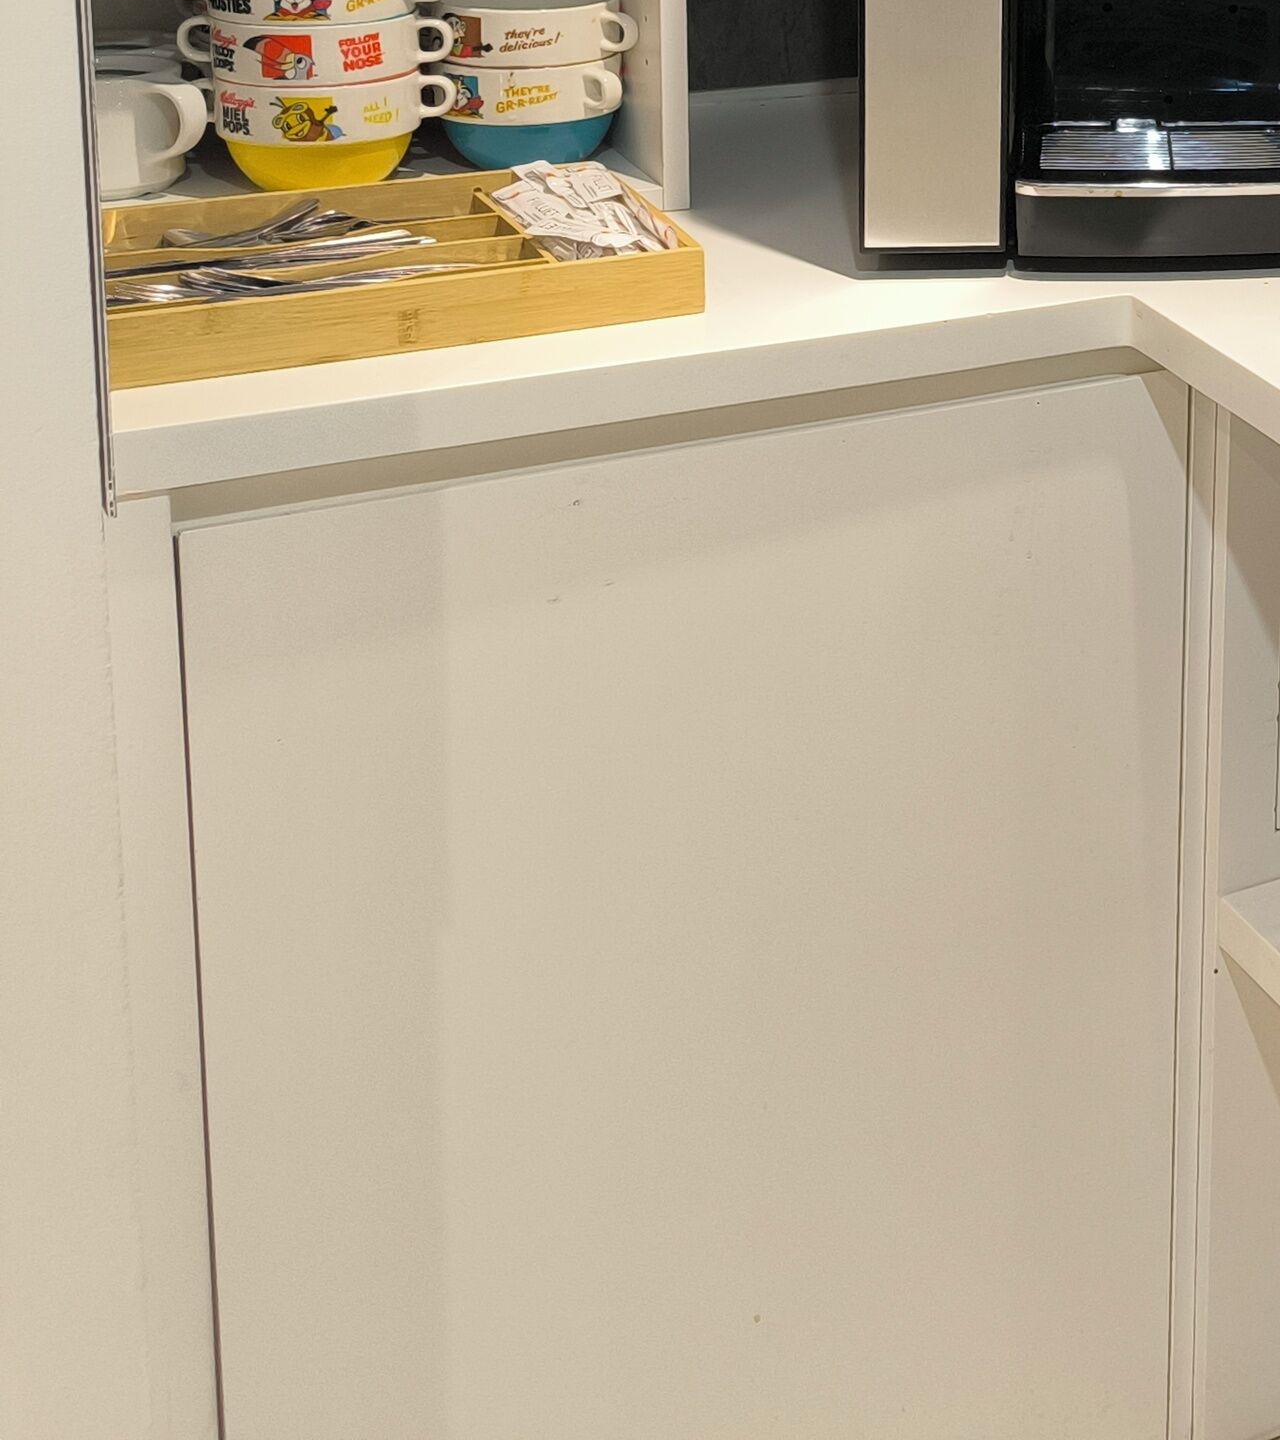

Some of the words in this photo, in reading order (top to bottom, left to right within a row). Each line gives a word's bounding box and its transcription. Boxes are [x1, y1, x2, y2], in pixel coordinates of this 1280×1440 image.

[338, 32, 380, 48] FOLLOW
[341, 42, 381, 60] YOUR
[343, 55, 384, 72] NOSE
[223, 106, 248, 123] MIEL
[223, 119, 251, 136] POPS
